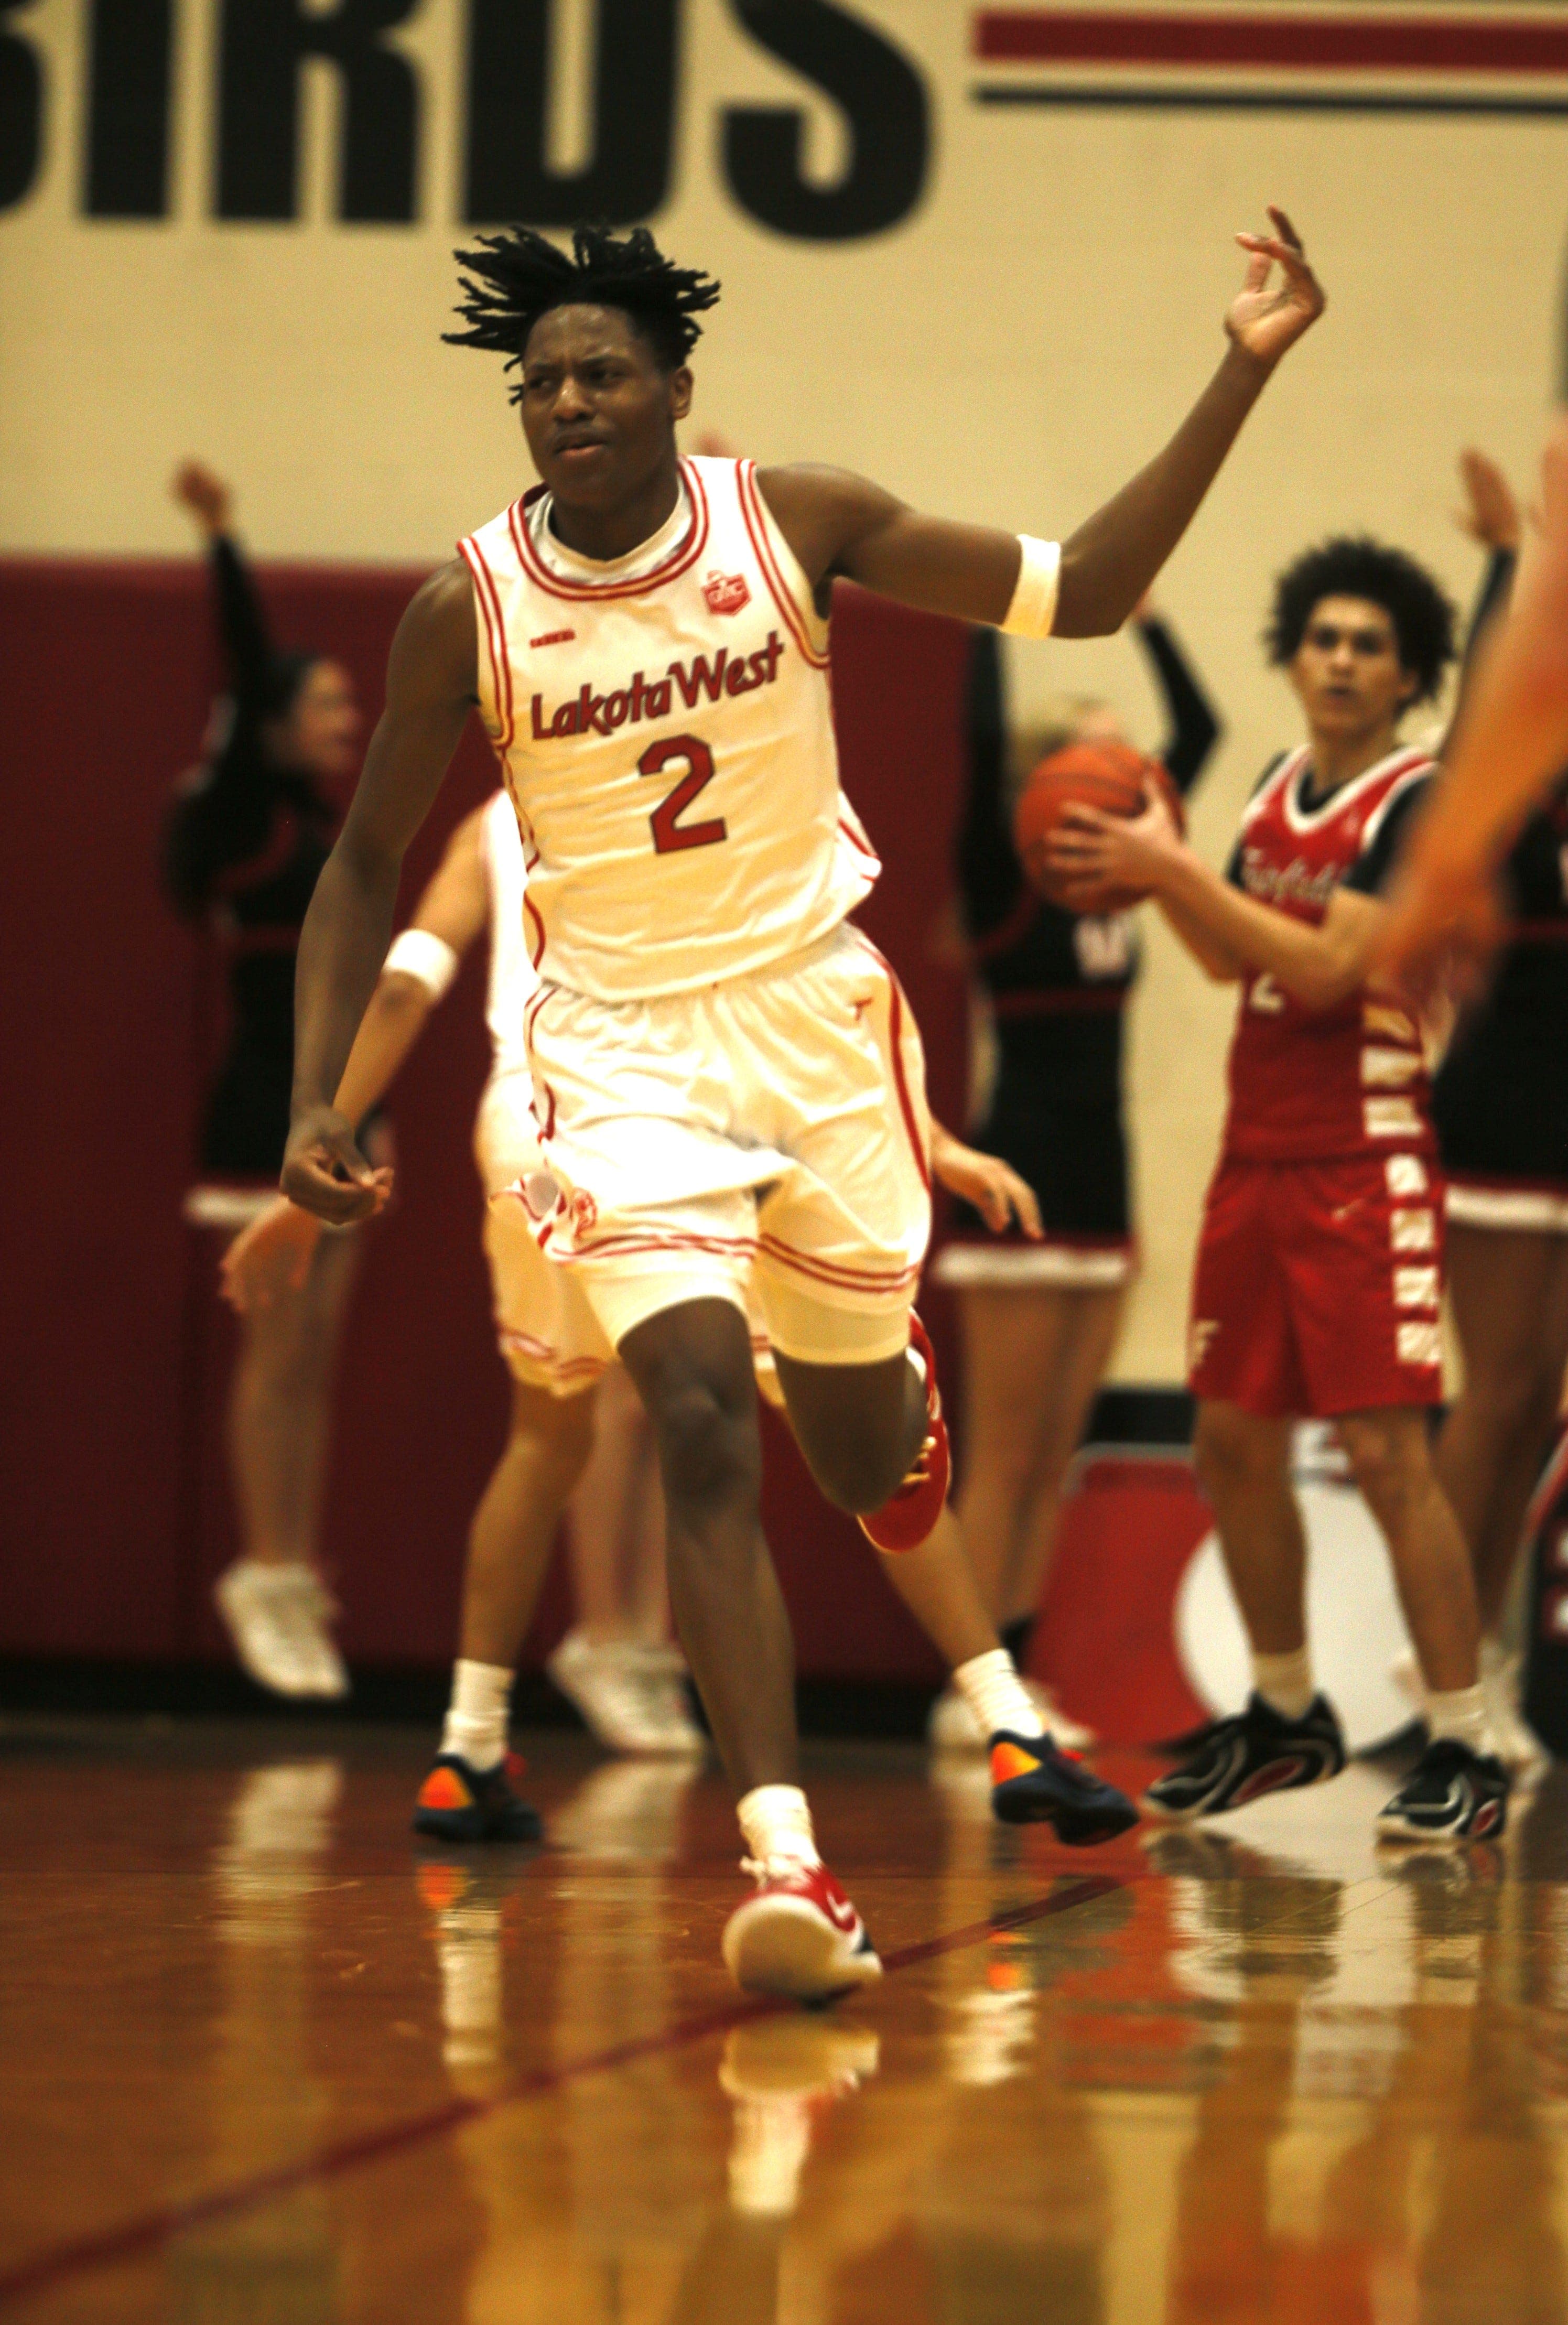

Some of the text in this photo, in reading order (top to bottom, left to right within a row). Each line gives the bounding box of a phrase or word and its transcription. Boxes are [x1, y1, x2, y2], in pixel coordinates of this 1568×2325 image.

[531, 630, 784, 741] Lakota West
[637, 733, 727, 855] 2
